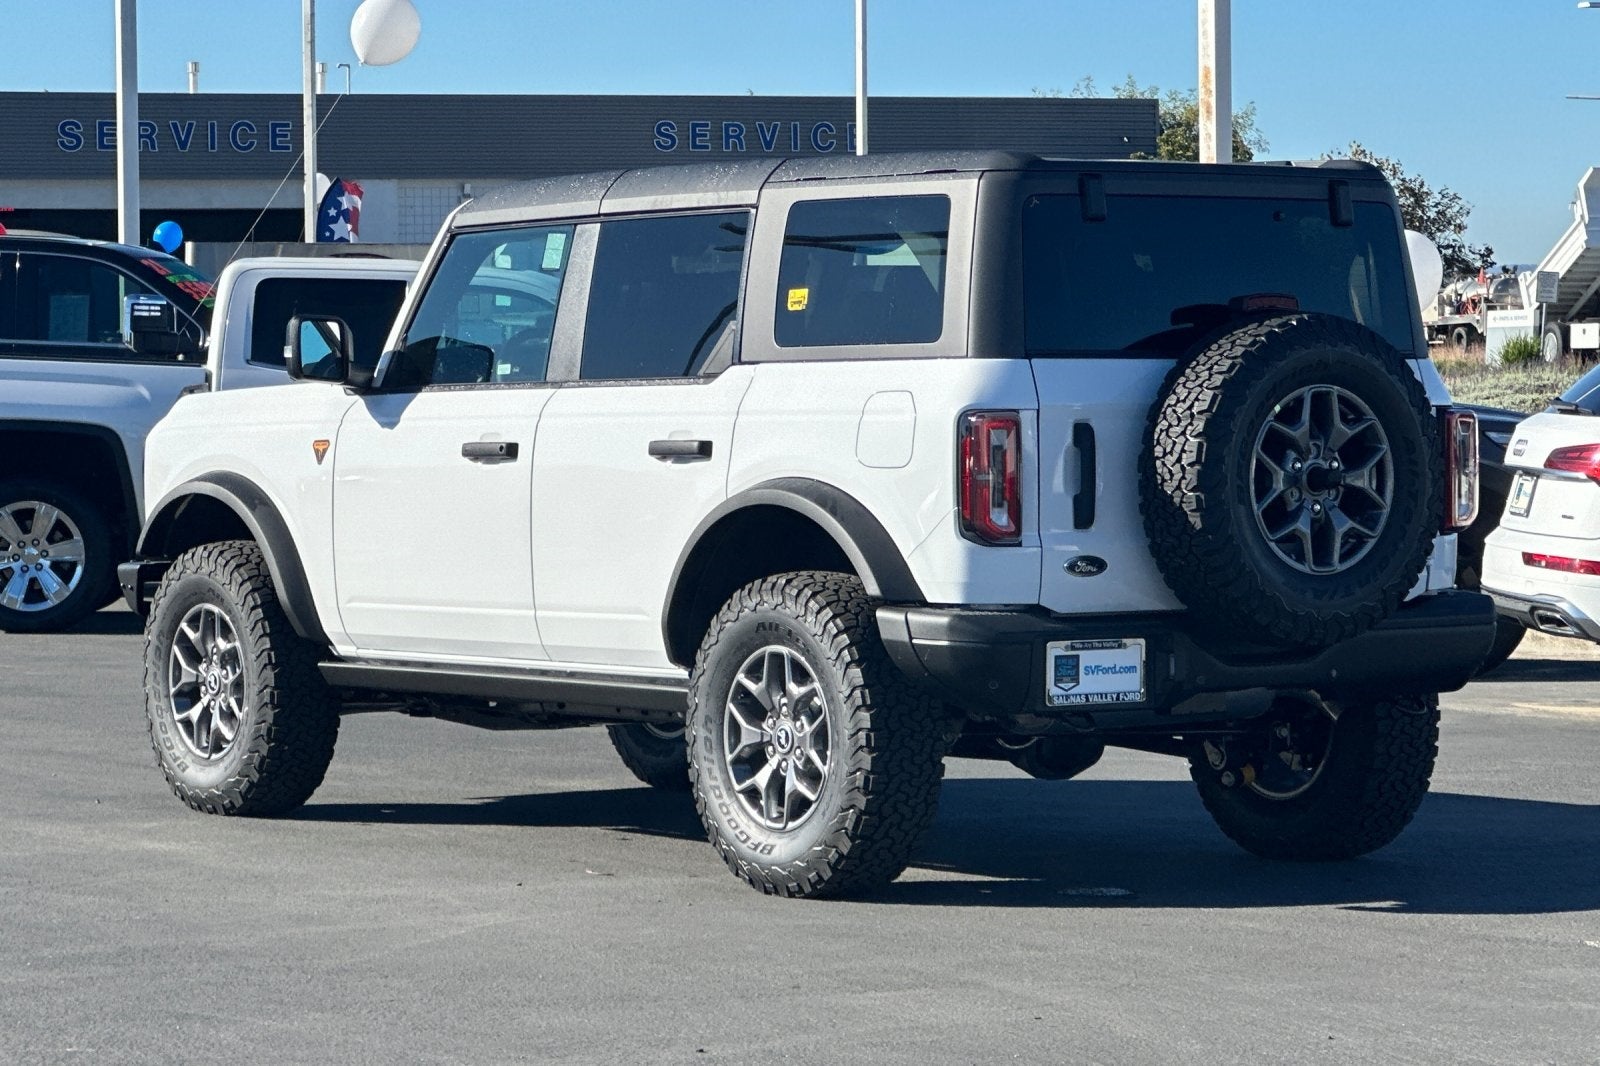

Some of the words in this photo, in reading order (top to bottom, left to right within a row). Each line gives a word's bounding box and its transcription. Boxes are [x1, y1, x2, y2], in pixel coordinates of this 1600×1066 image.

[57, 119, 293, 152] SERVICE
[1083, 664, 1137, 676] SVFord.com
[1053, 694, 1086, 705] SALINAS
[1088, 693, 1117, 703] VALLEY
[1119, 692, 1141, 702] FORD
